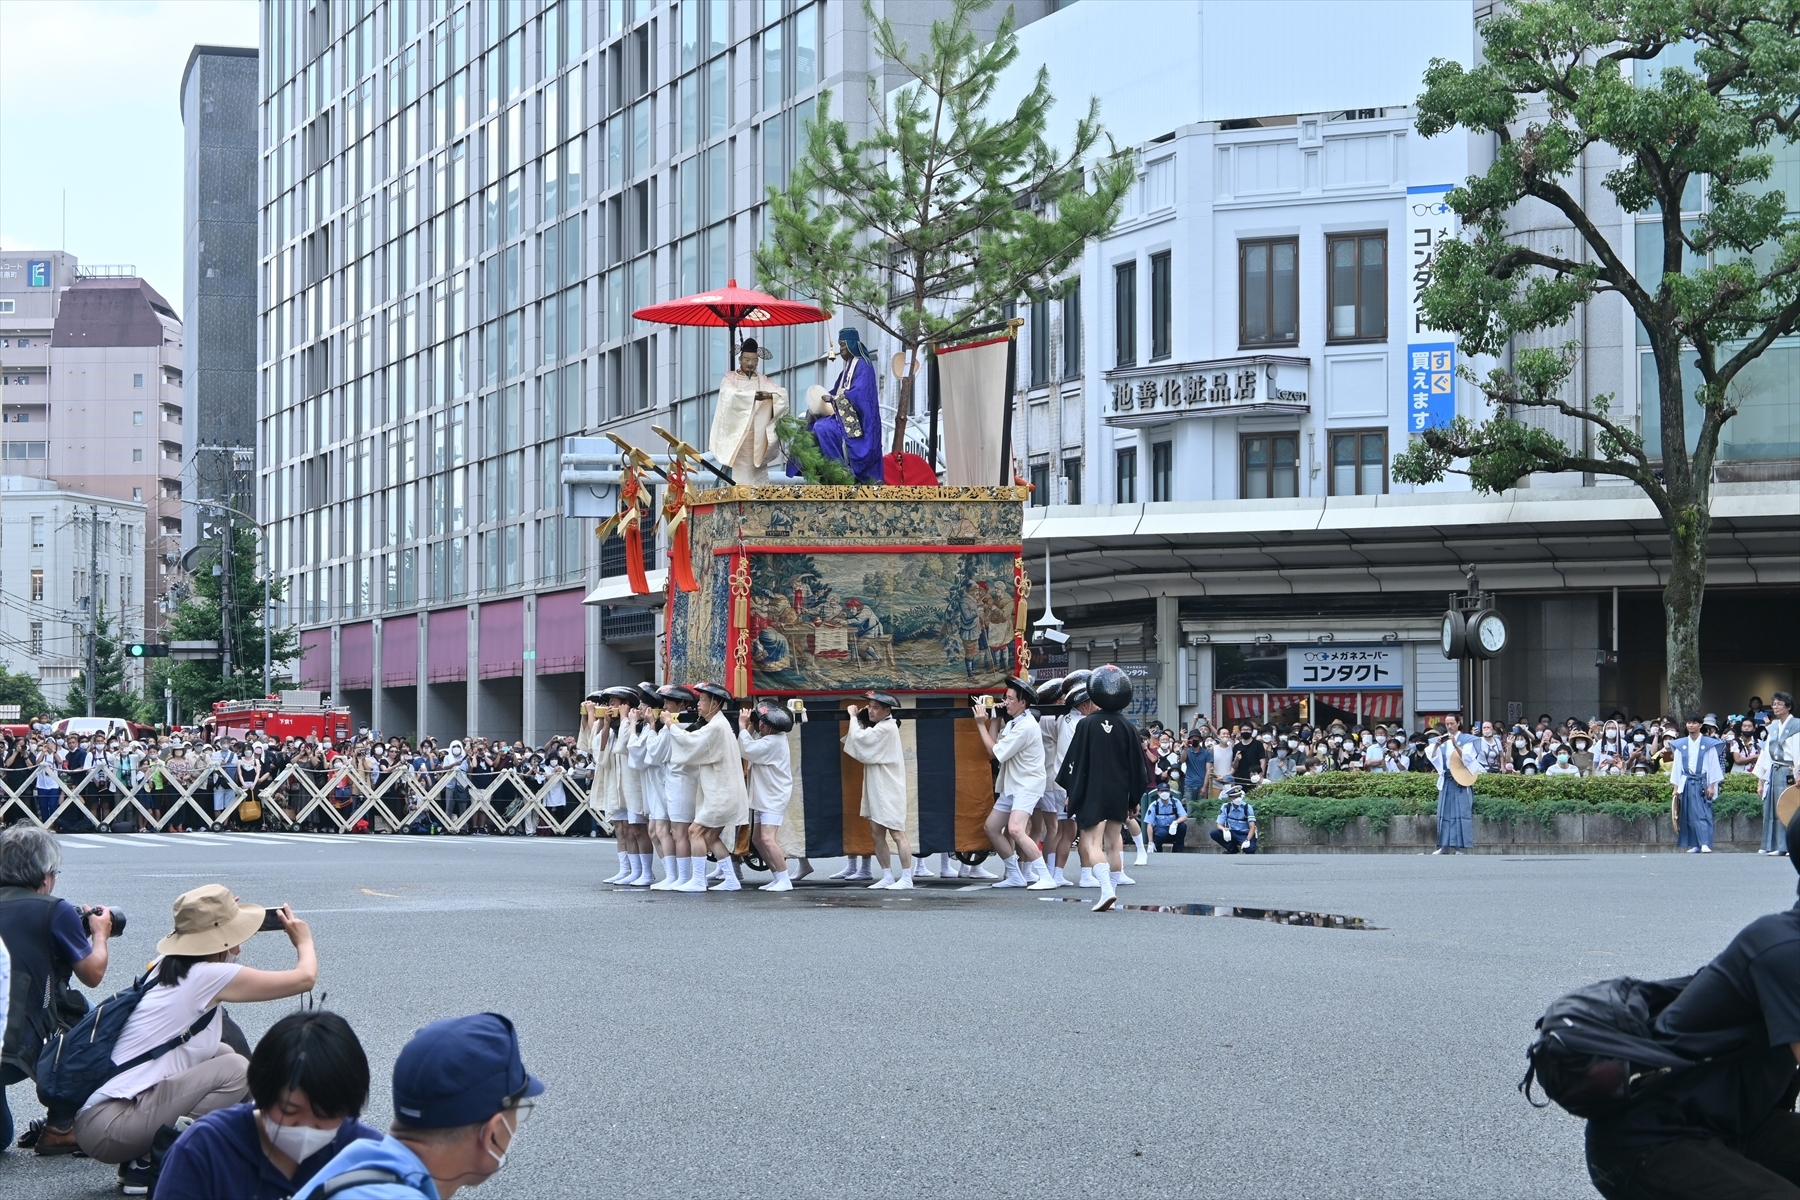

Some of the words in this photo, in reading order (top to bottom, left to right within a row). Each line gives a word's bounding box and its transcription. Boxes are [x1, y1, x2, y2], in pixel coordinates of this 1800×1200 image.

[1432, 352, 1449, 392] すぐ
[1111, 371, 1257, 411] 池善化粧品店
[1412, 351, 1430, 430] 買えます
[1331, 651, 1389, 661] メガネスーパー
[1037, 668, 1053, 680] ACCESS
[1303, 664, 1389, 682] コンタクト
